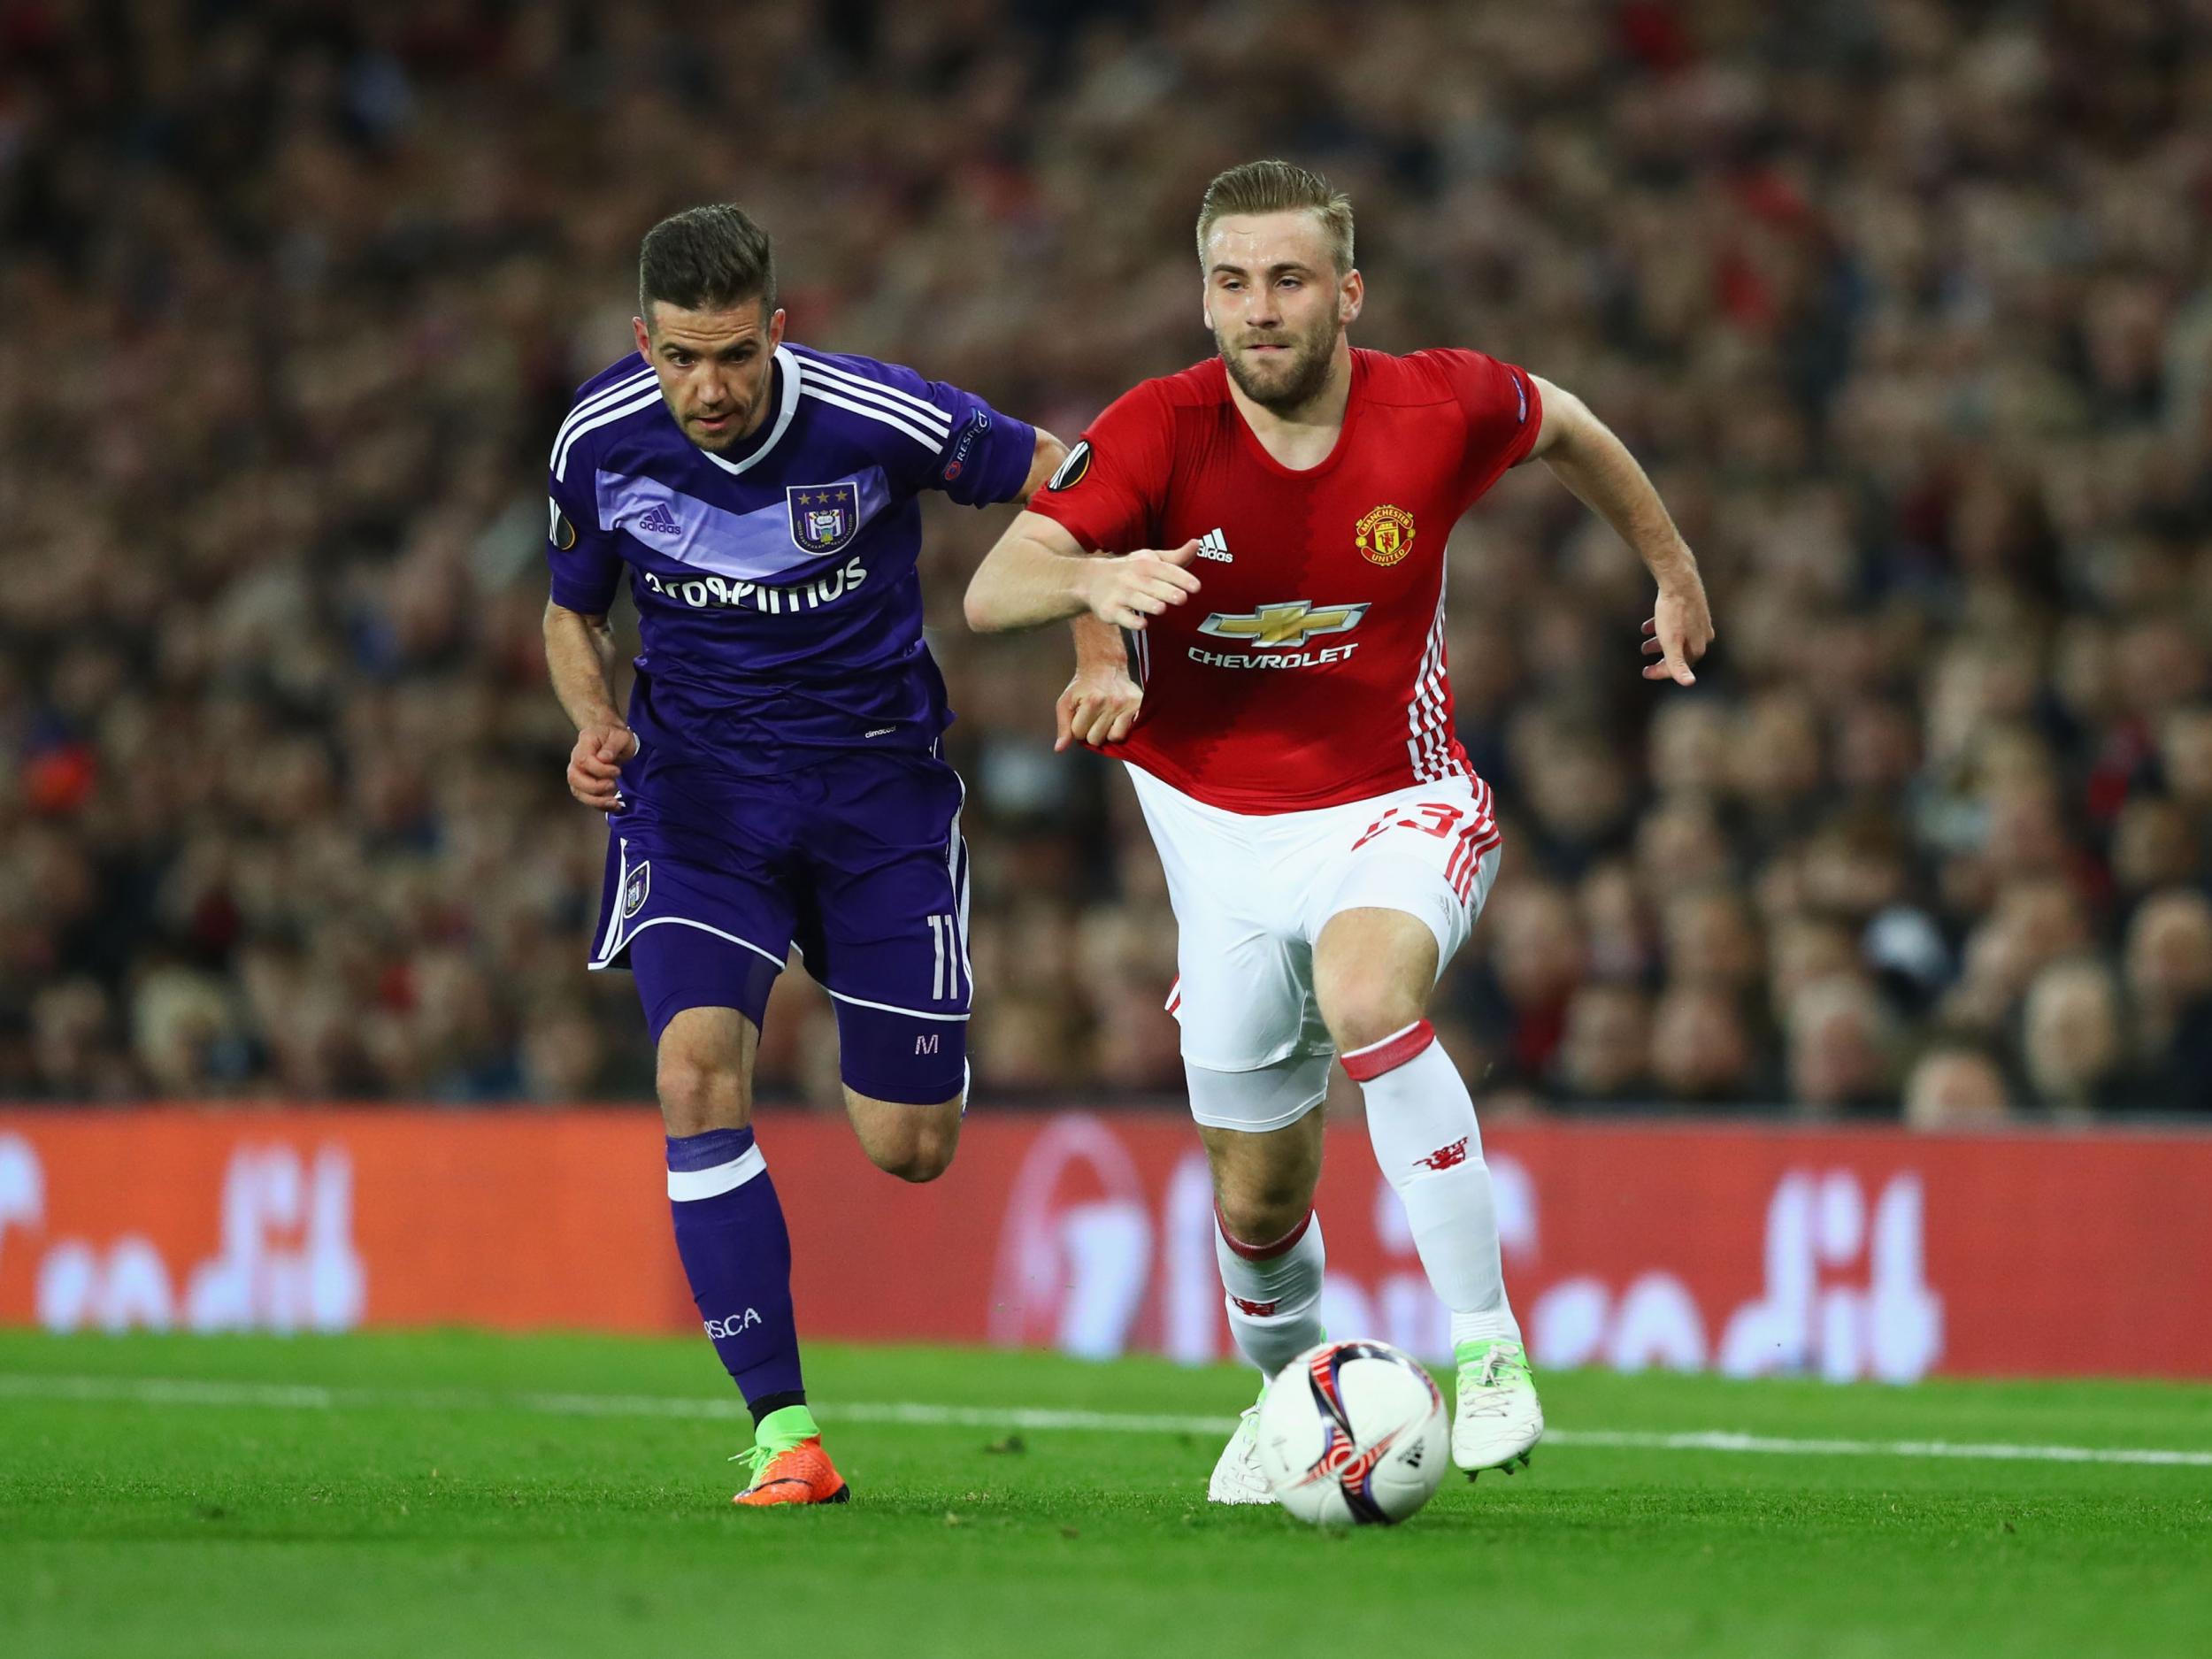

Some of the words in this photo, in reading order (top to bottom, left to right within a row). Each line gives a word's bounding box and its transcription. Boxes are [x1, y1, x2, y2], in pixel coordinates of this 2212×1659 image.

[639, 519, 681, 535] adidas
[1361, 509, 1409, 533] MANCHESTER
[1371, 549, 1405, 563] UNITED
[1187, 642, 1359, 670] CHEVROLET
[927, 914, 957, 1001] 11
[703, 1307, 762, 1340] RSCA
